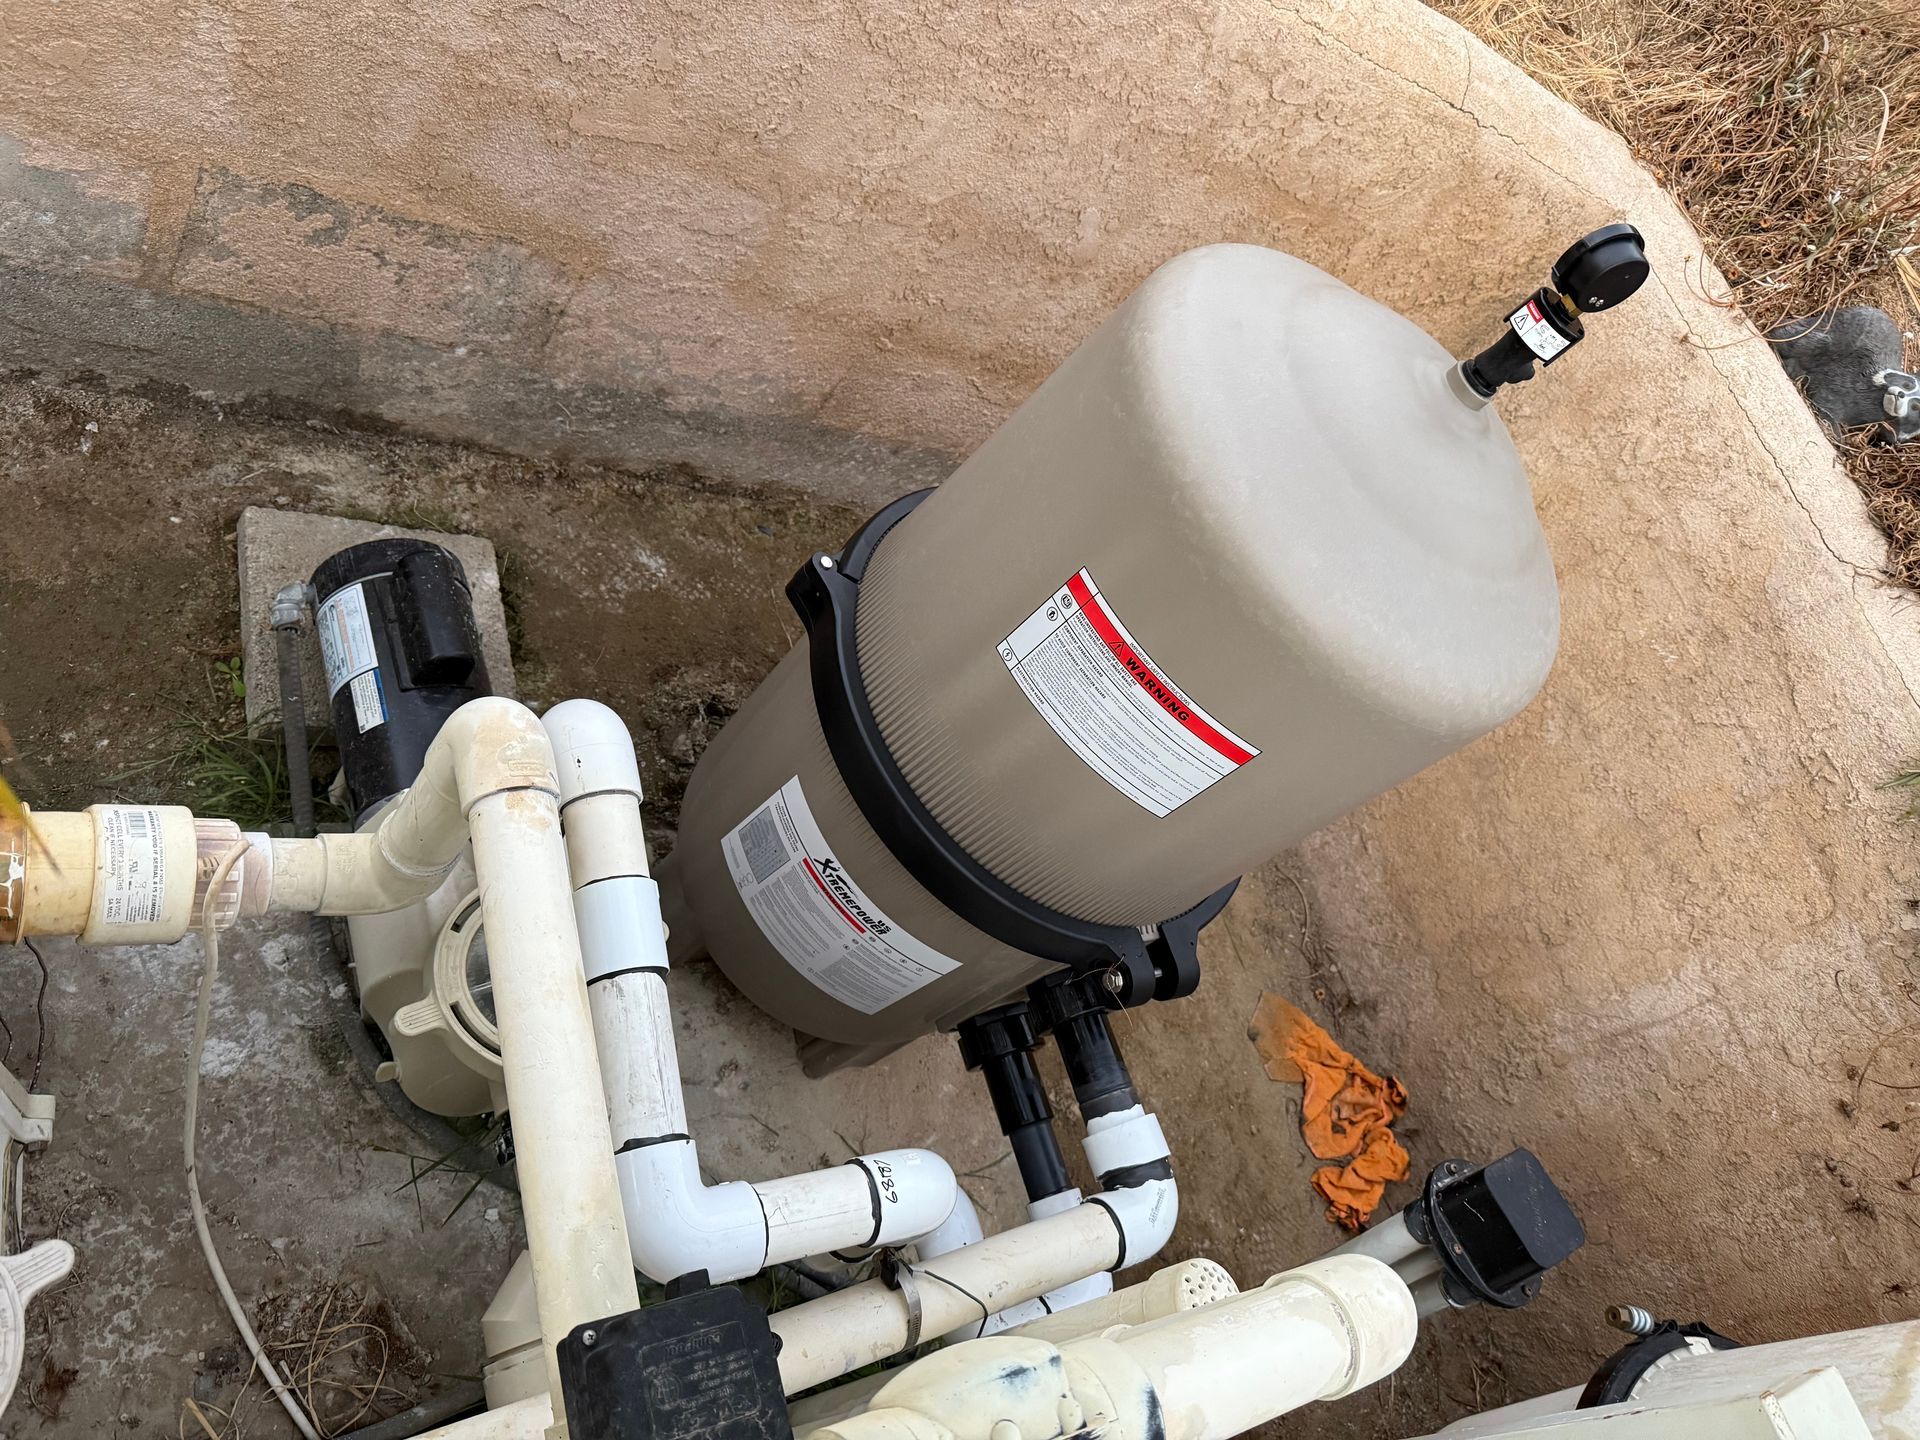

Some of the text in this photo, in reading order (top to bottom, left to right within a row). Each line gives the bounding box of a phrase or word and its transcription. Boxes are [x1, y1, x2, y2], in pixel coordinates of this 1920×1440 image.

[1126, 657, 1189, 721] WARNING
[1129, 642, 1191, 706] IMPORTANT SAFETY INSTRUCTIONS
